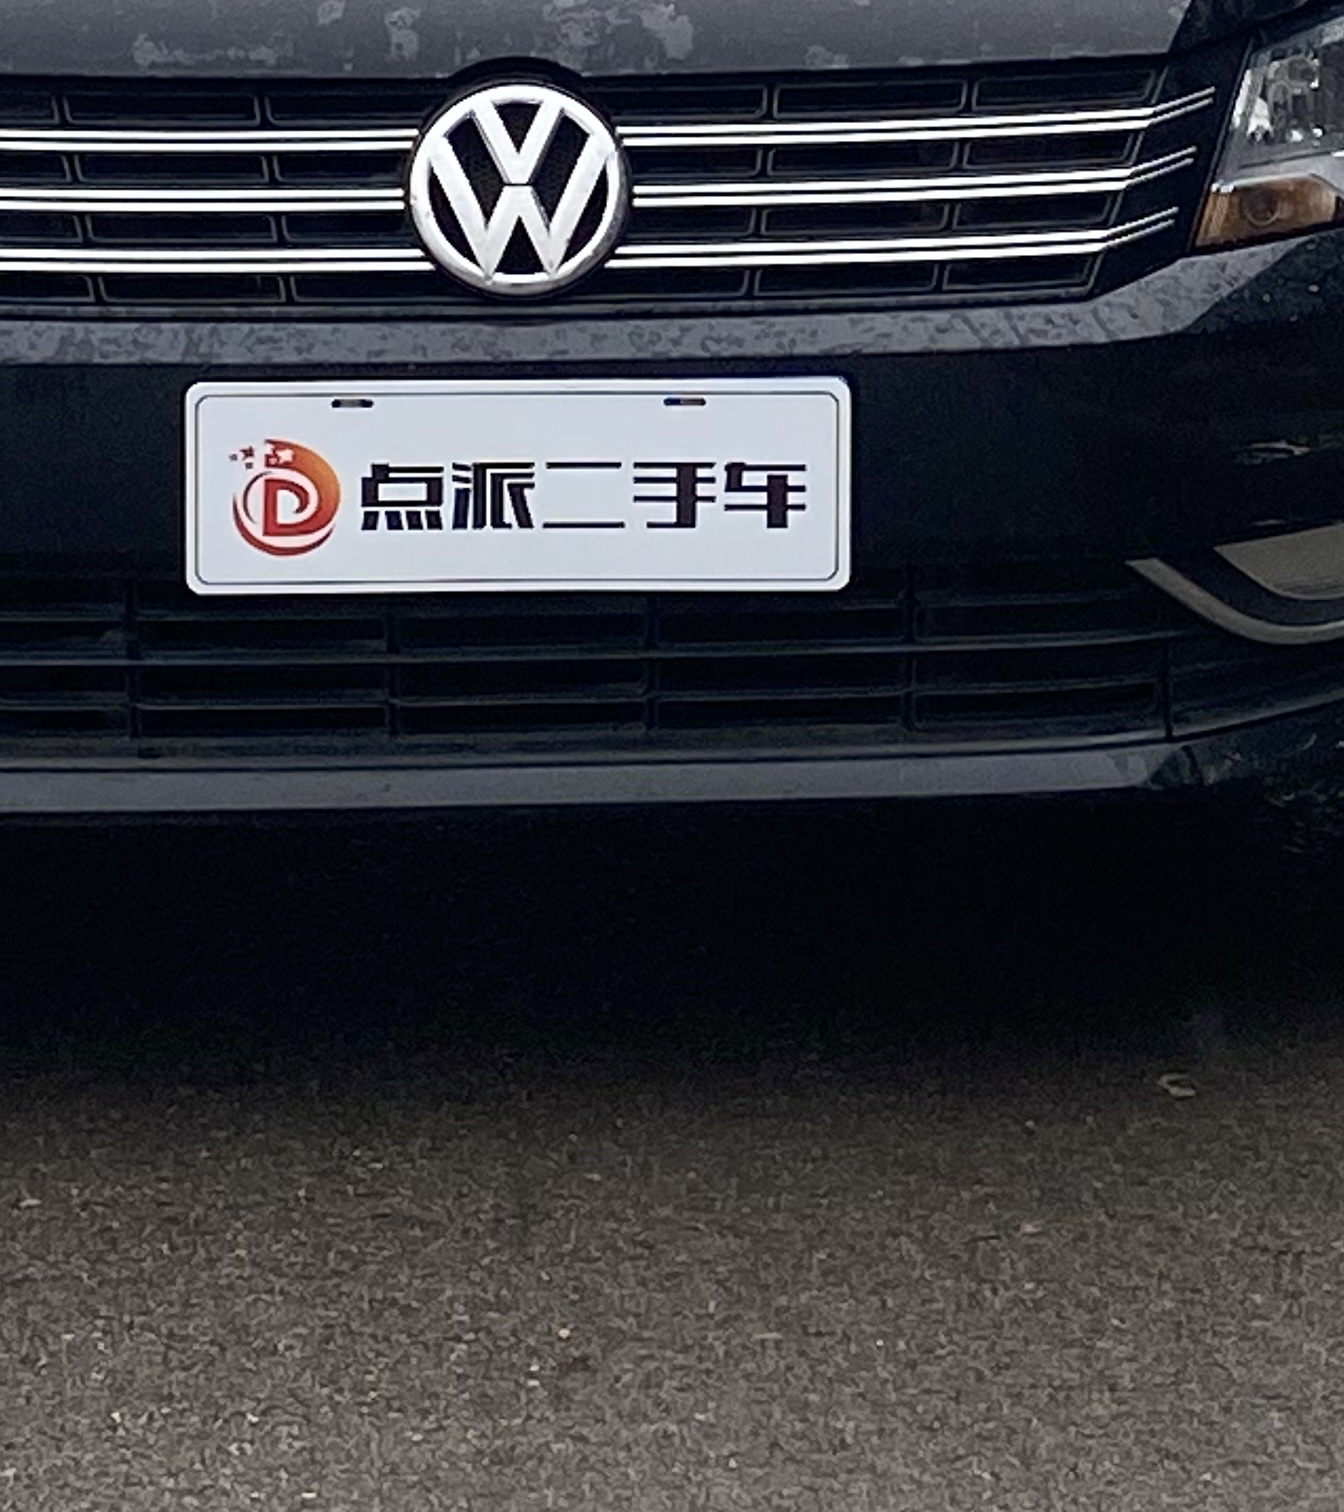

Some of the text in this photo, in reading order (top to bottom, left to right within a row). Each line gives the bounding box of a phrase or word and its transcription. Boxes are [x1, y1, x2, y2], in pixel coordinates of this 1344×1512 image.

[424, 92, 616, 285] VW
[361, 462, 807, 531] 点派二手车
